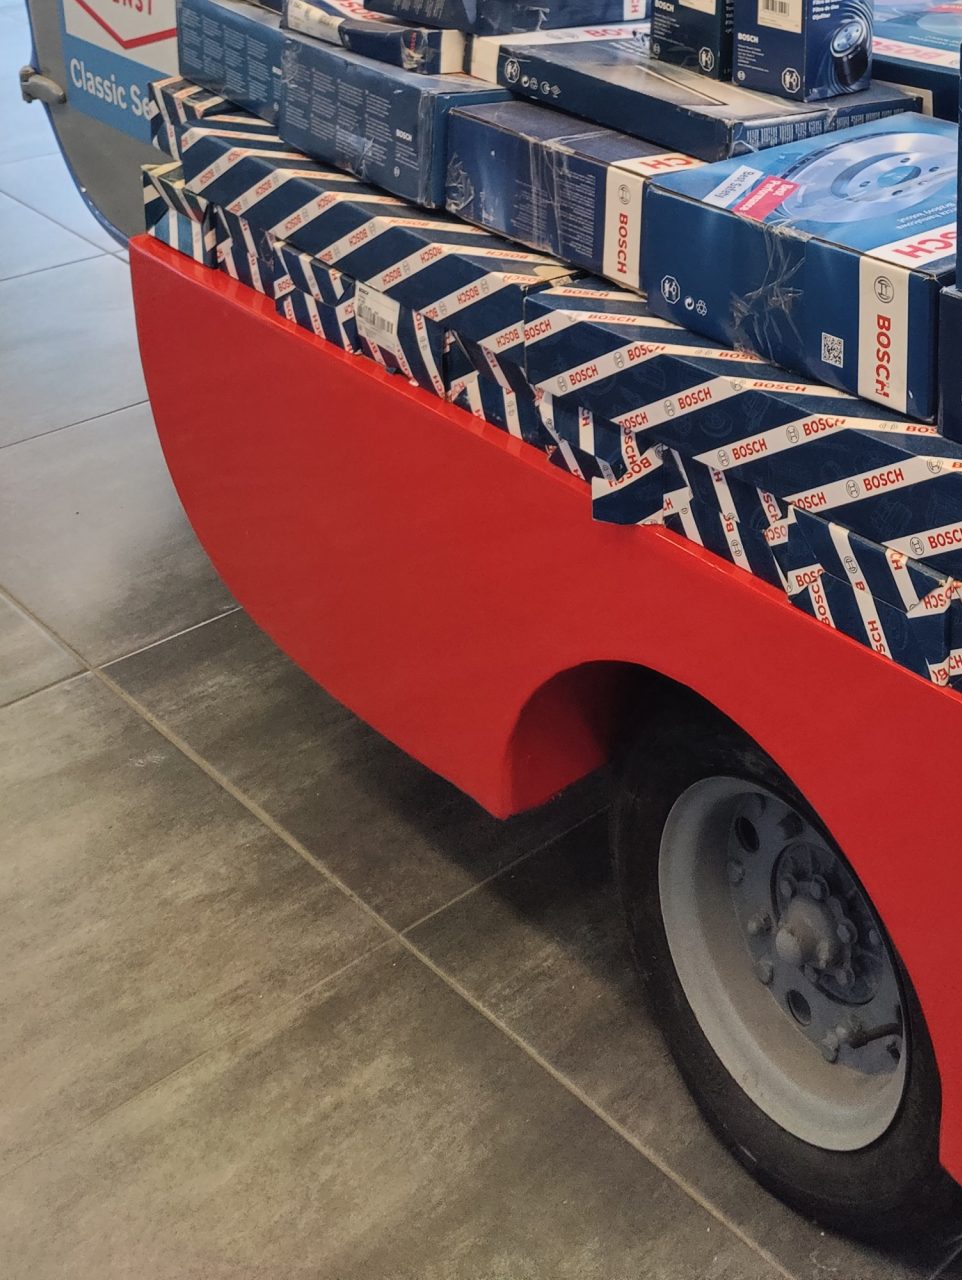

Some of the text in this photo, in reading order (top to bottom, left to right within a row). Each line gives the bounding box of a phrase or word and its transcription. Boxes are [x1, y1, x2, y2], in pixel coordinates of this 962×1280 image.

[737, 32, 759, 44] BOSCH
[70, 58, 151, 122] Classic Se
[350, 229, 369, 246] BOSCH
[616, 213, 629, 275] BOSCH
[420, 247, 442, 264] BOSCH
[383, 267, 402, 285] BOSCH
[457, 286, 480, 305] BOSCH
[563, 288, 609, 297] BOSCH
[588, 313, 637, 323] BOSCH
[497, 329, 519, 348] BOSCH
[524, 320, 552, 340] BOSCH
[627, 344, 666, 361] BOSCH
[874, 313, 891, 398] BOSCH
[570, 364, 599, 385] BOSCH
[753, 381, 807, 393] BOSCH
[678, 387, 712, 410] BOSCH
[803, 417, 846, 437] BOSCH
[732, 438, 767, 461] BOSCH
[863, 468, 905, 492] BOSCH
